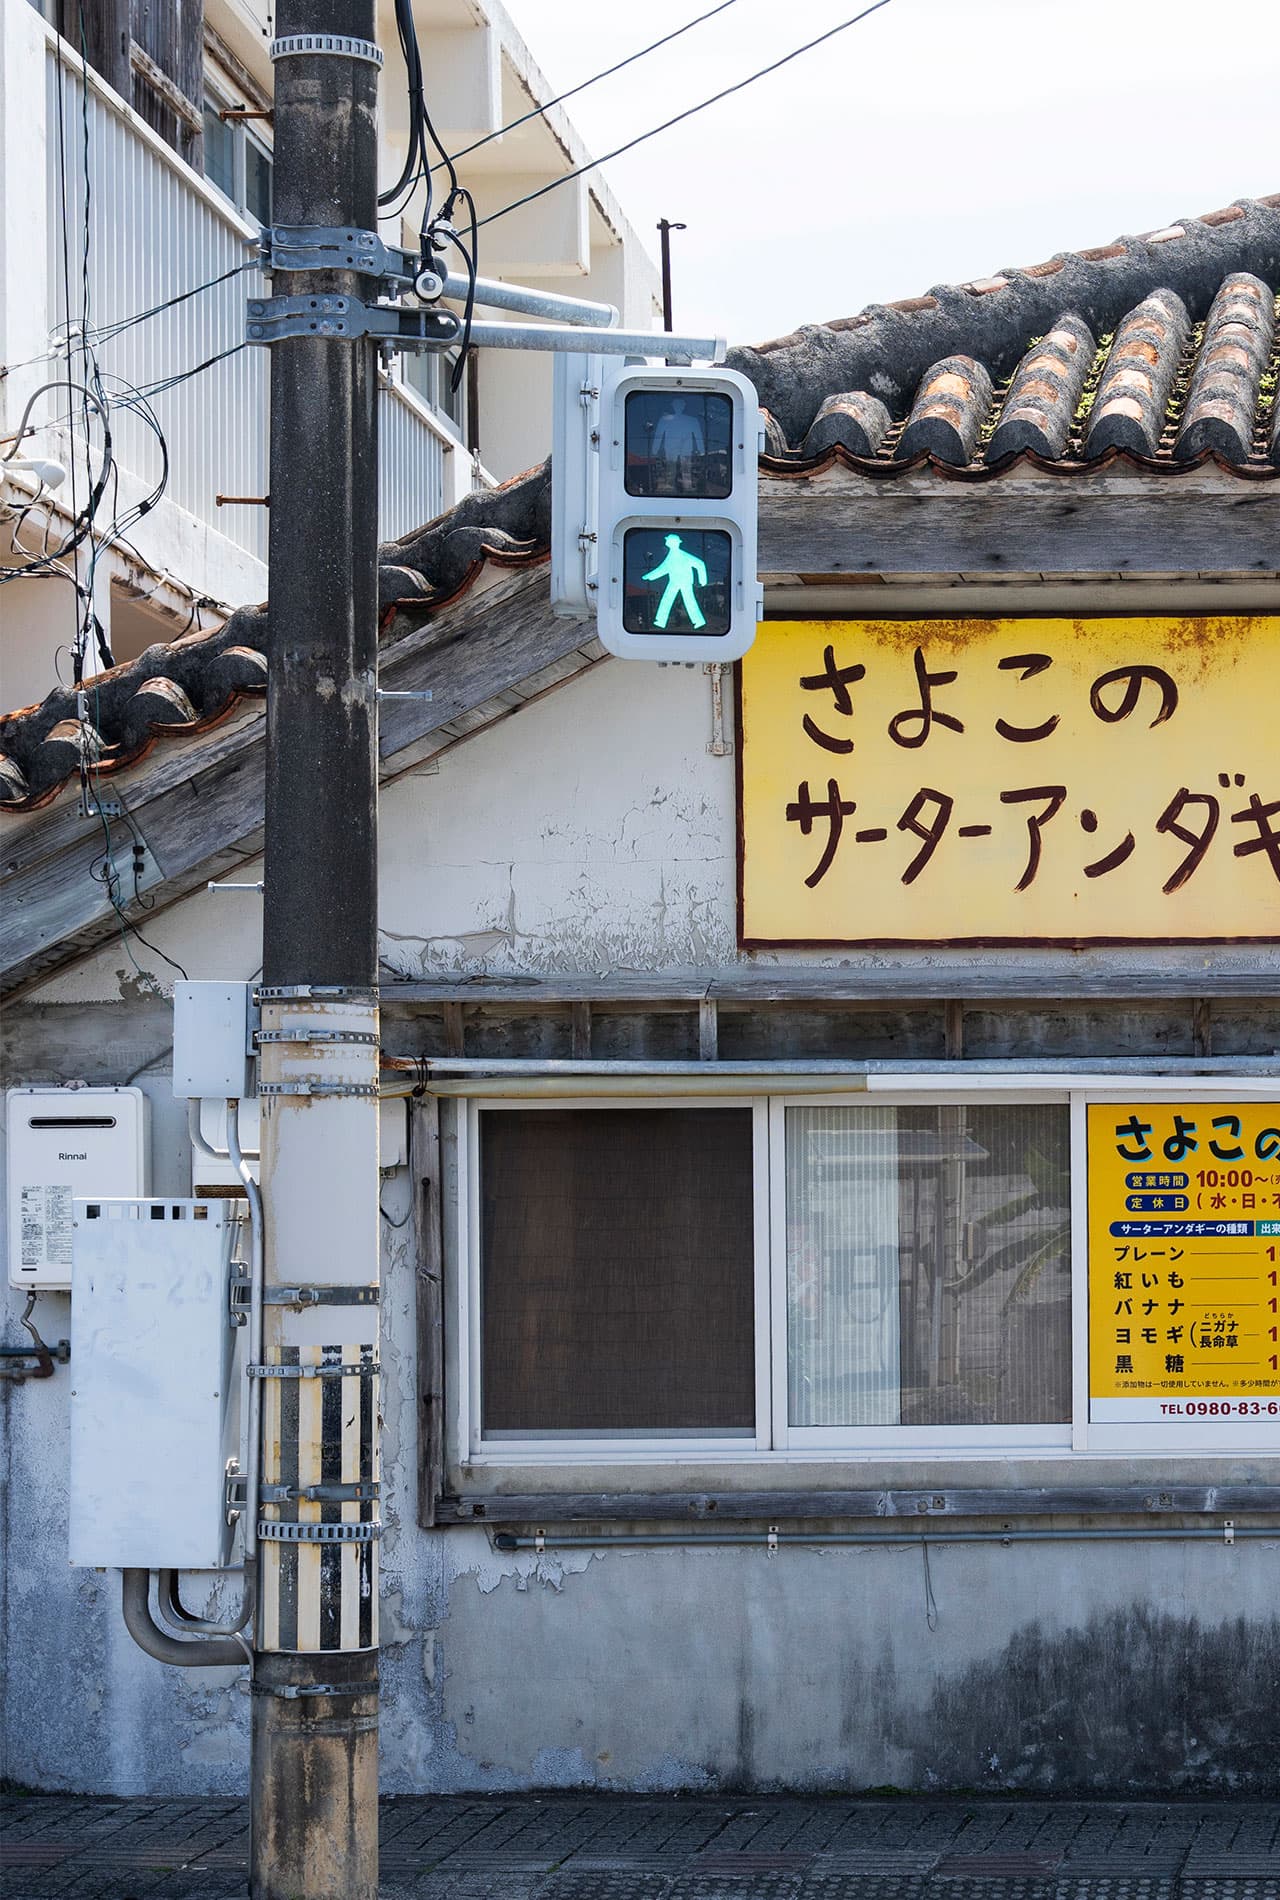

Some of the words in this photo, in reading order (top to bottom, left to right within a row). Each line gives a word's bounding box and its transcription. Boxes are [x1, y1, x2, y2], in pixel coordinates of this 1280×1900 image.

[799, 645, 1180, 755] さよこの
[58, 1152, 87, 1161] Rinnai
[1131, 1175, 1184, 1187] 営業時間
[1131, 1197, 1184, 1209] 定休日
[1121, 1223, 1248, 1235] サーターアンダギーの種類
[1114, 1246, 1185, 1262] プレーン
[1114, 1271, 1185, 1290] 紅いも
[1114, 1298, 1185, 1316] バナナ
[1116, 1325, 1184, 1344] ヨモギ
[1200, 1320, 1239, 1333] ニガナ
[1200, 1335, 1239, 1348] 長命草
[1115, 1354, 1185, 1374] 黒糖
